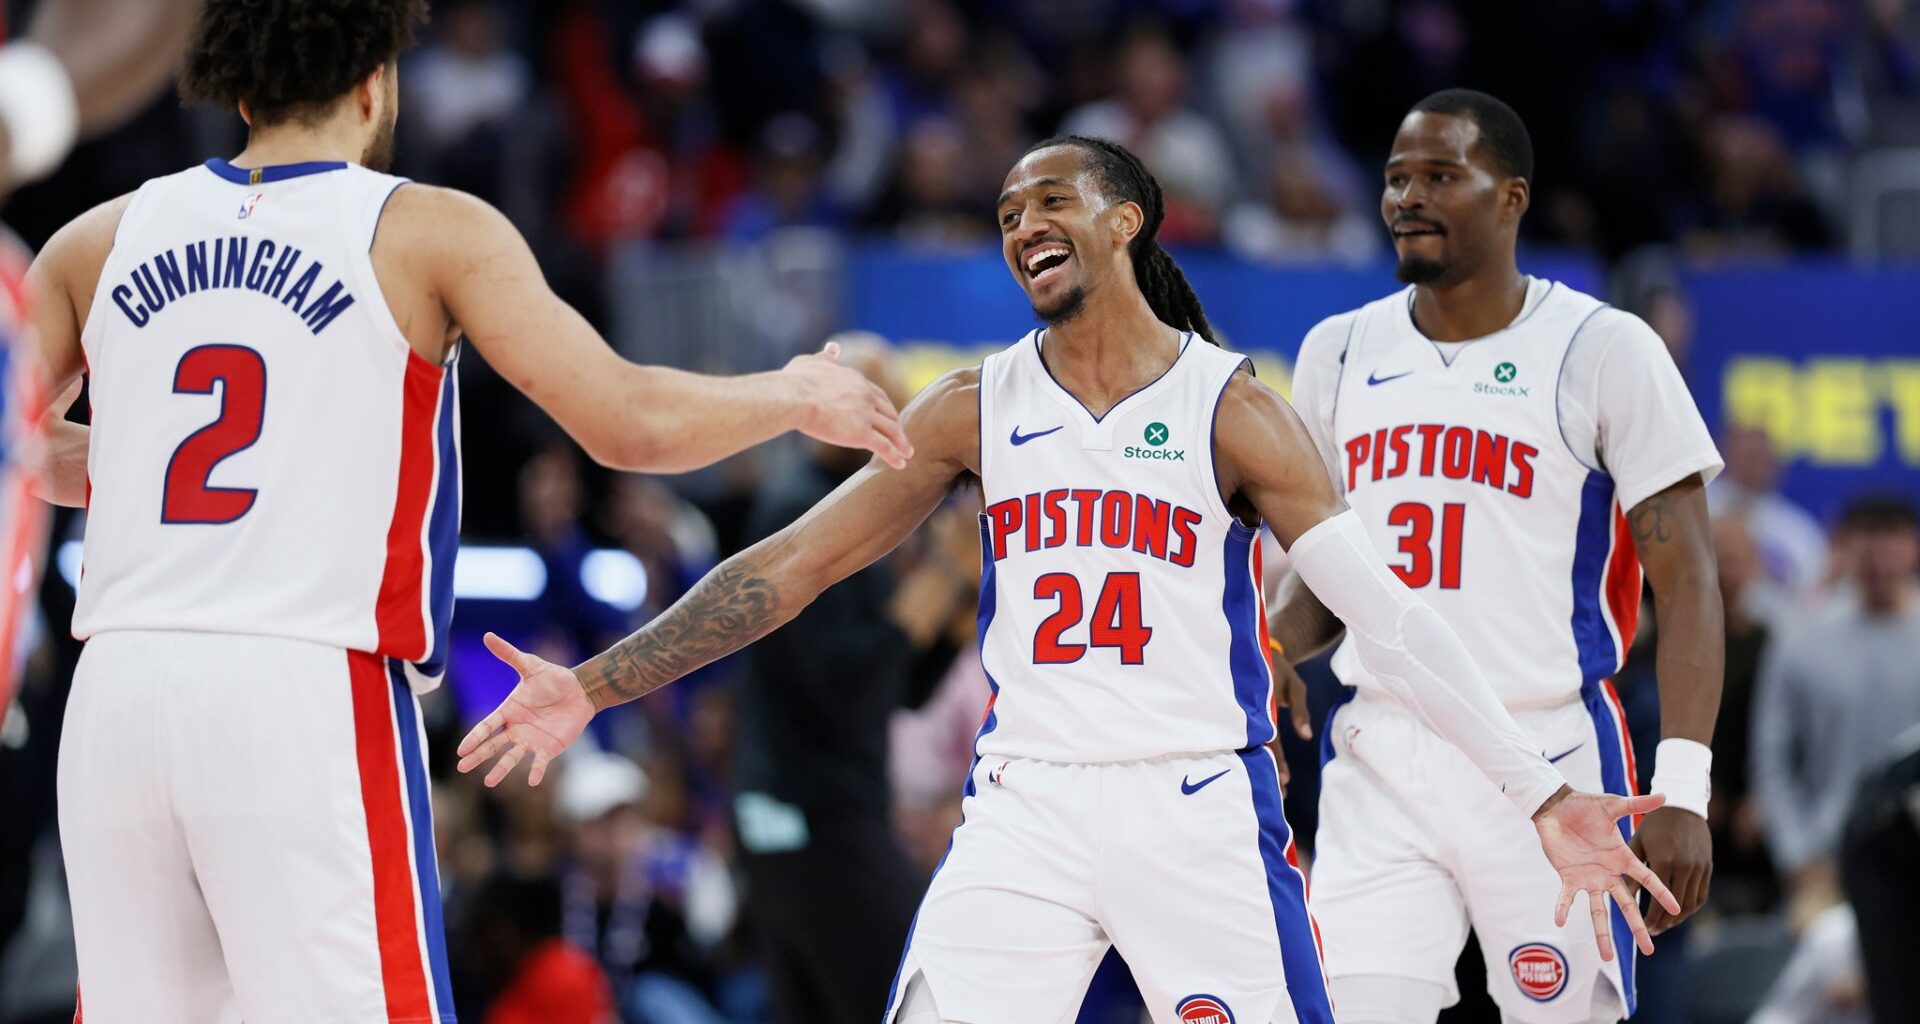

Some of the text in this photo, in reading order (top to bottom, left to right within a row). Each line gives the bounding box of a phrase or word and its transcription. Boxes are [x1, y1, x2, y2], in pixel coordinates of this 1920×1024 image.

[111, 236, 356, 336] CUNNINGHAM
[1472, 382, 1529, 397] StockX
[160, 343, 267, 525] 2
[1124, 446, 1185, 461] StockX
[1345, 424, 1539, 499] PISTONS
[987, 488, 1203, 568] PISTONS
[1387, 502, 1466, 590] 31
[1032, 571, 1153, 665] 24
